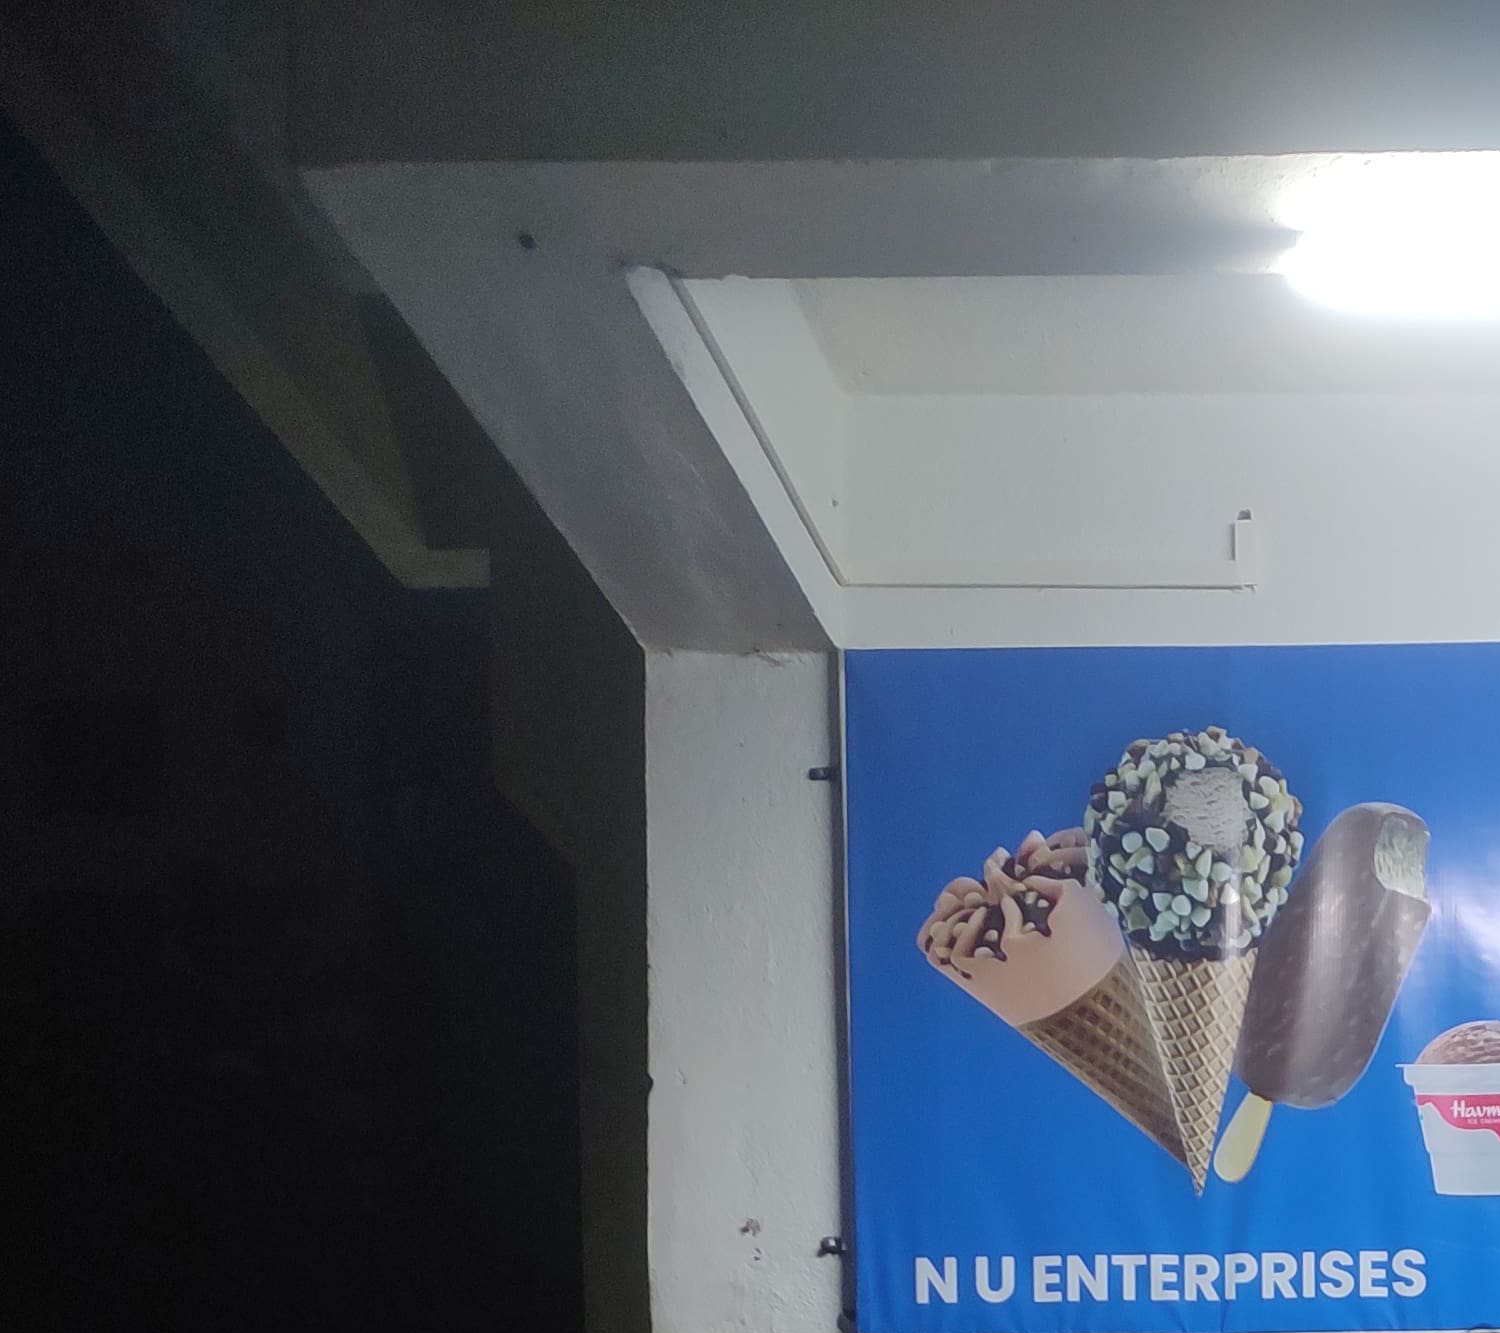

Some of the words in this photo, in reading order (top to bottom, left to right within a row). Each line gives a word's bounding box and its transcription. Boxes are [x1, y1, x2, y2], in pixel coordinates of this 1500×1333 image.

[915, 1256, 959, 1305] N
[974, 1255, 1016, 1305] U
[1032, 1248, 1428, 1304] ENTERPRISES
